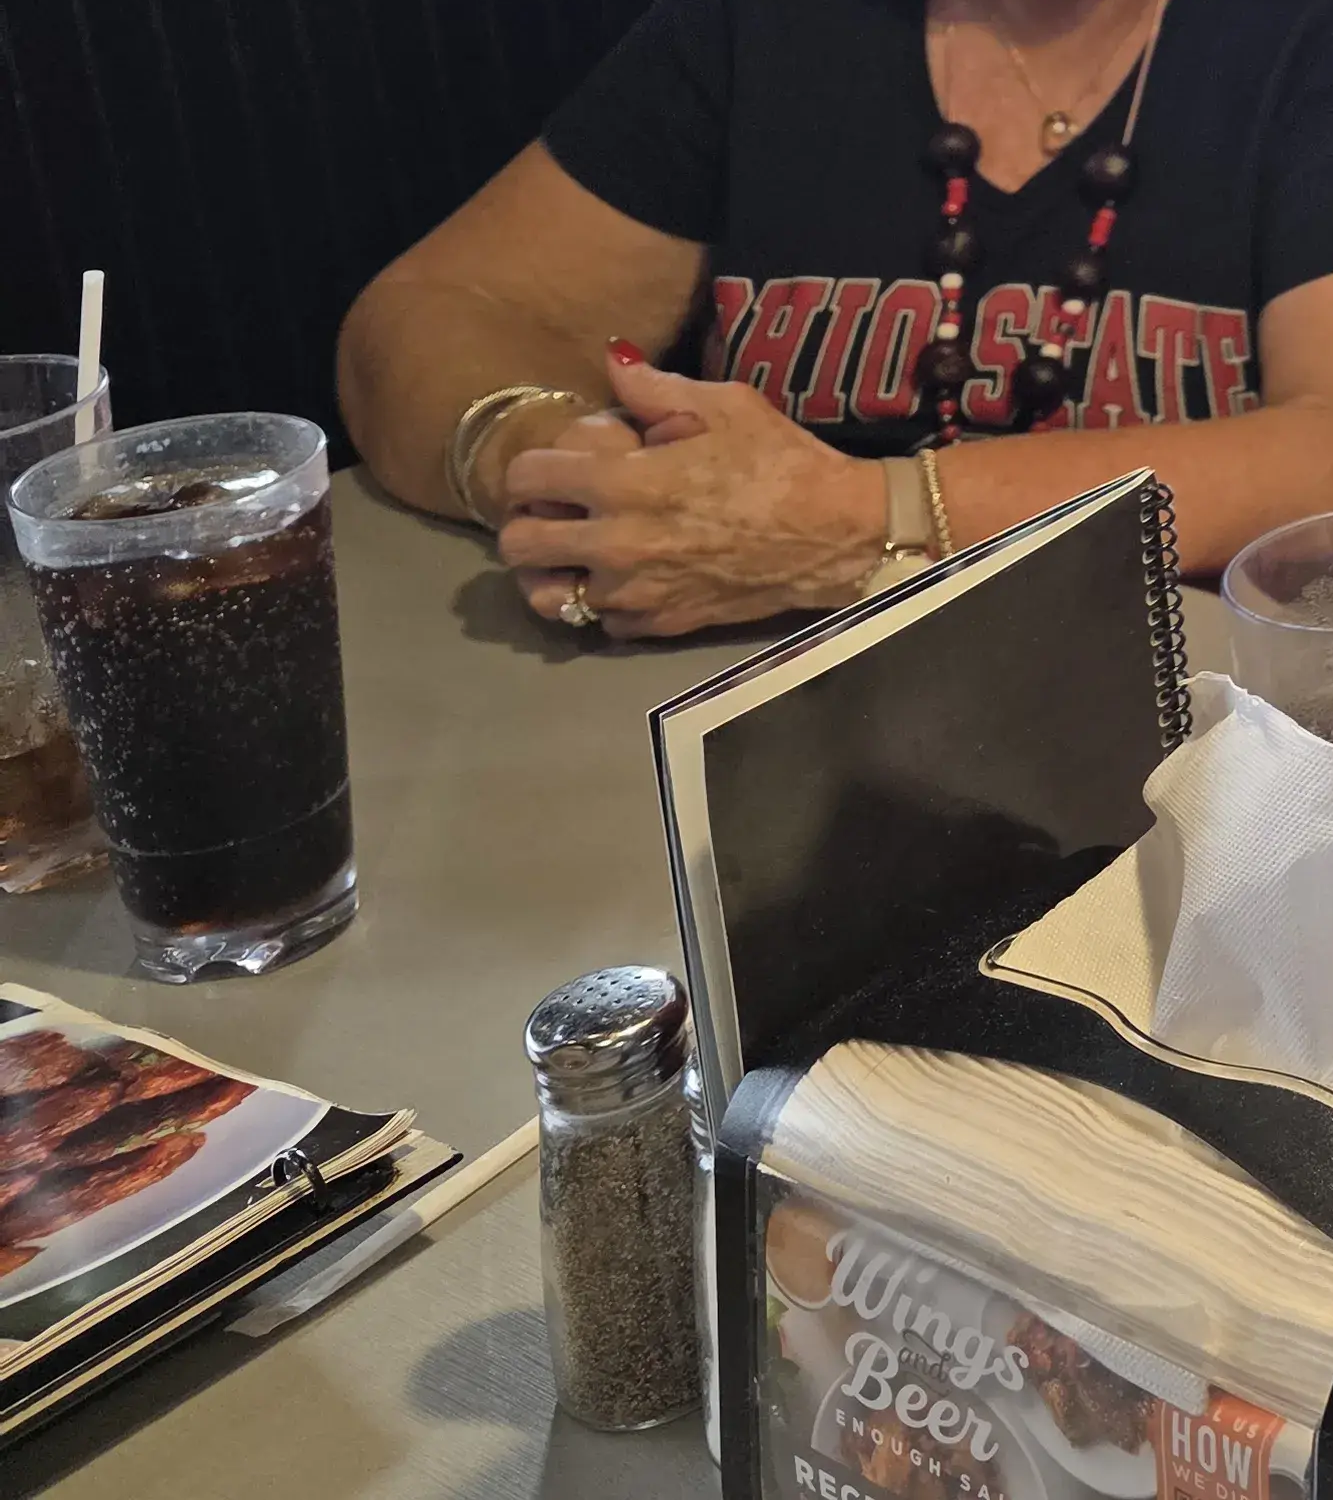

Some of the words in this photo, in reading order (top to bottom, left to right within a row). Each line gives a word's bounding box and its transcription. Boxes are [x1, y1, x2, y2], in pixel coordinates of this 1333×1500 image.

[825, 1231, 1030, 1391] Wings
[898, 1328, 952, 1384] and
[841, 1331, 999, 1462] Beer
[793, 1454, 878, 1500] REC
[835, 1407, 942, 1478] ENOUGH
[1171, 1410, 1253, 1491] HOW
[1171, 1461, 1206, 1491] WE
